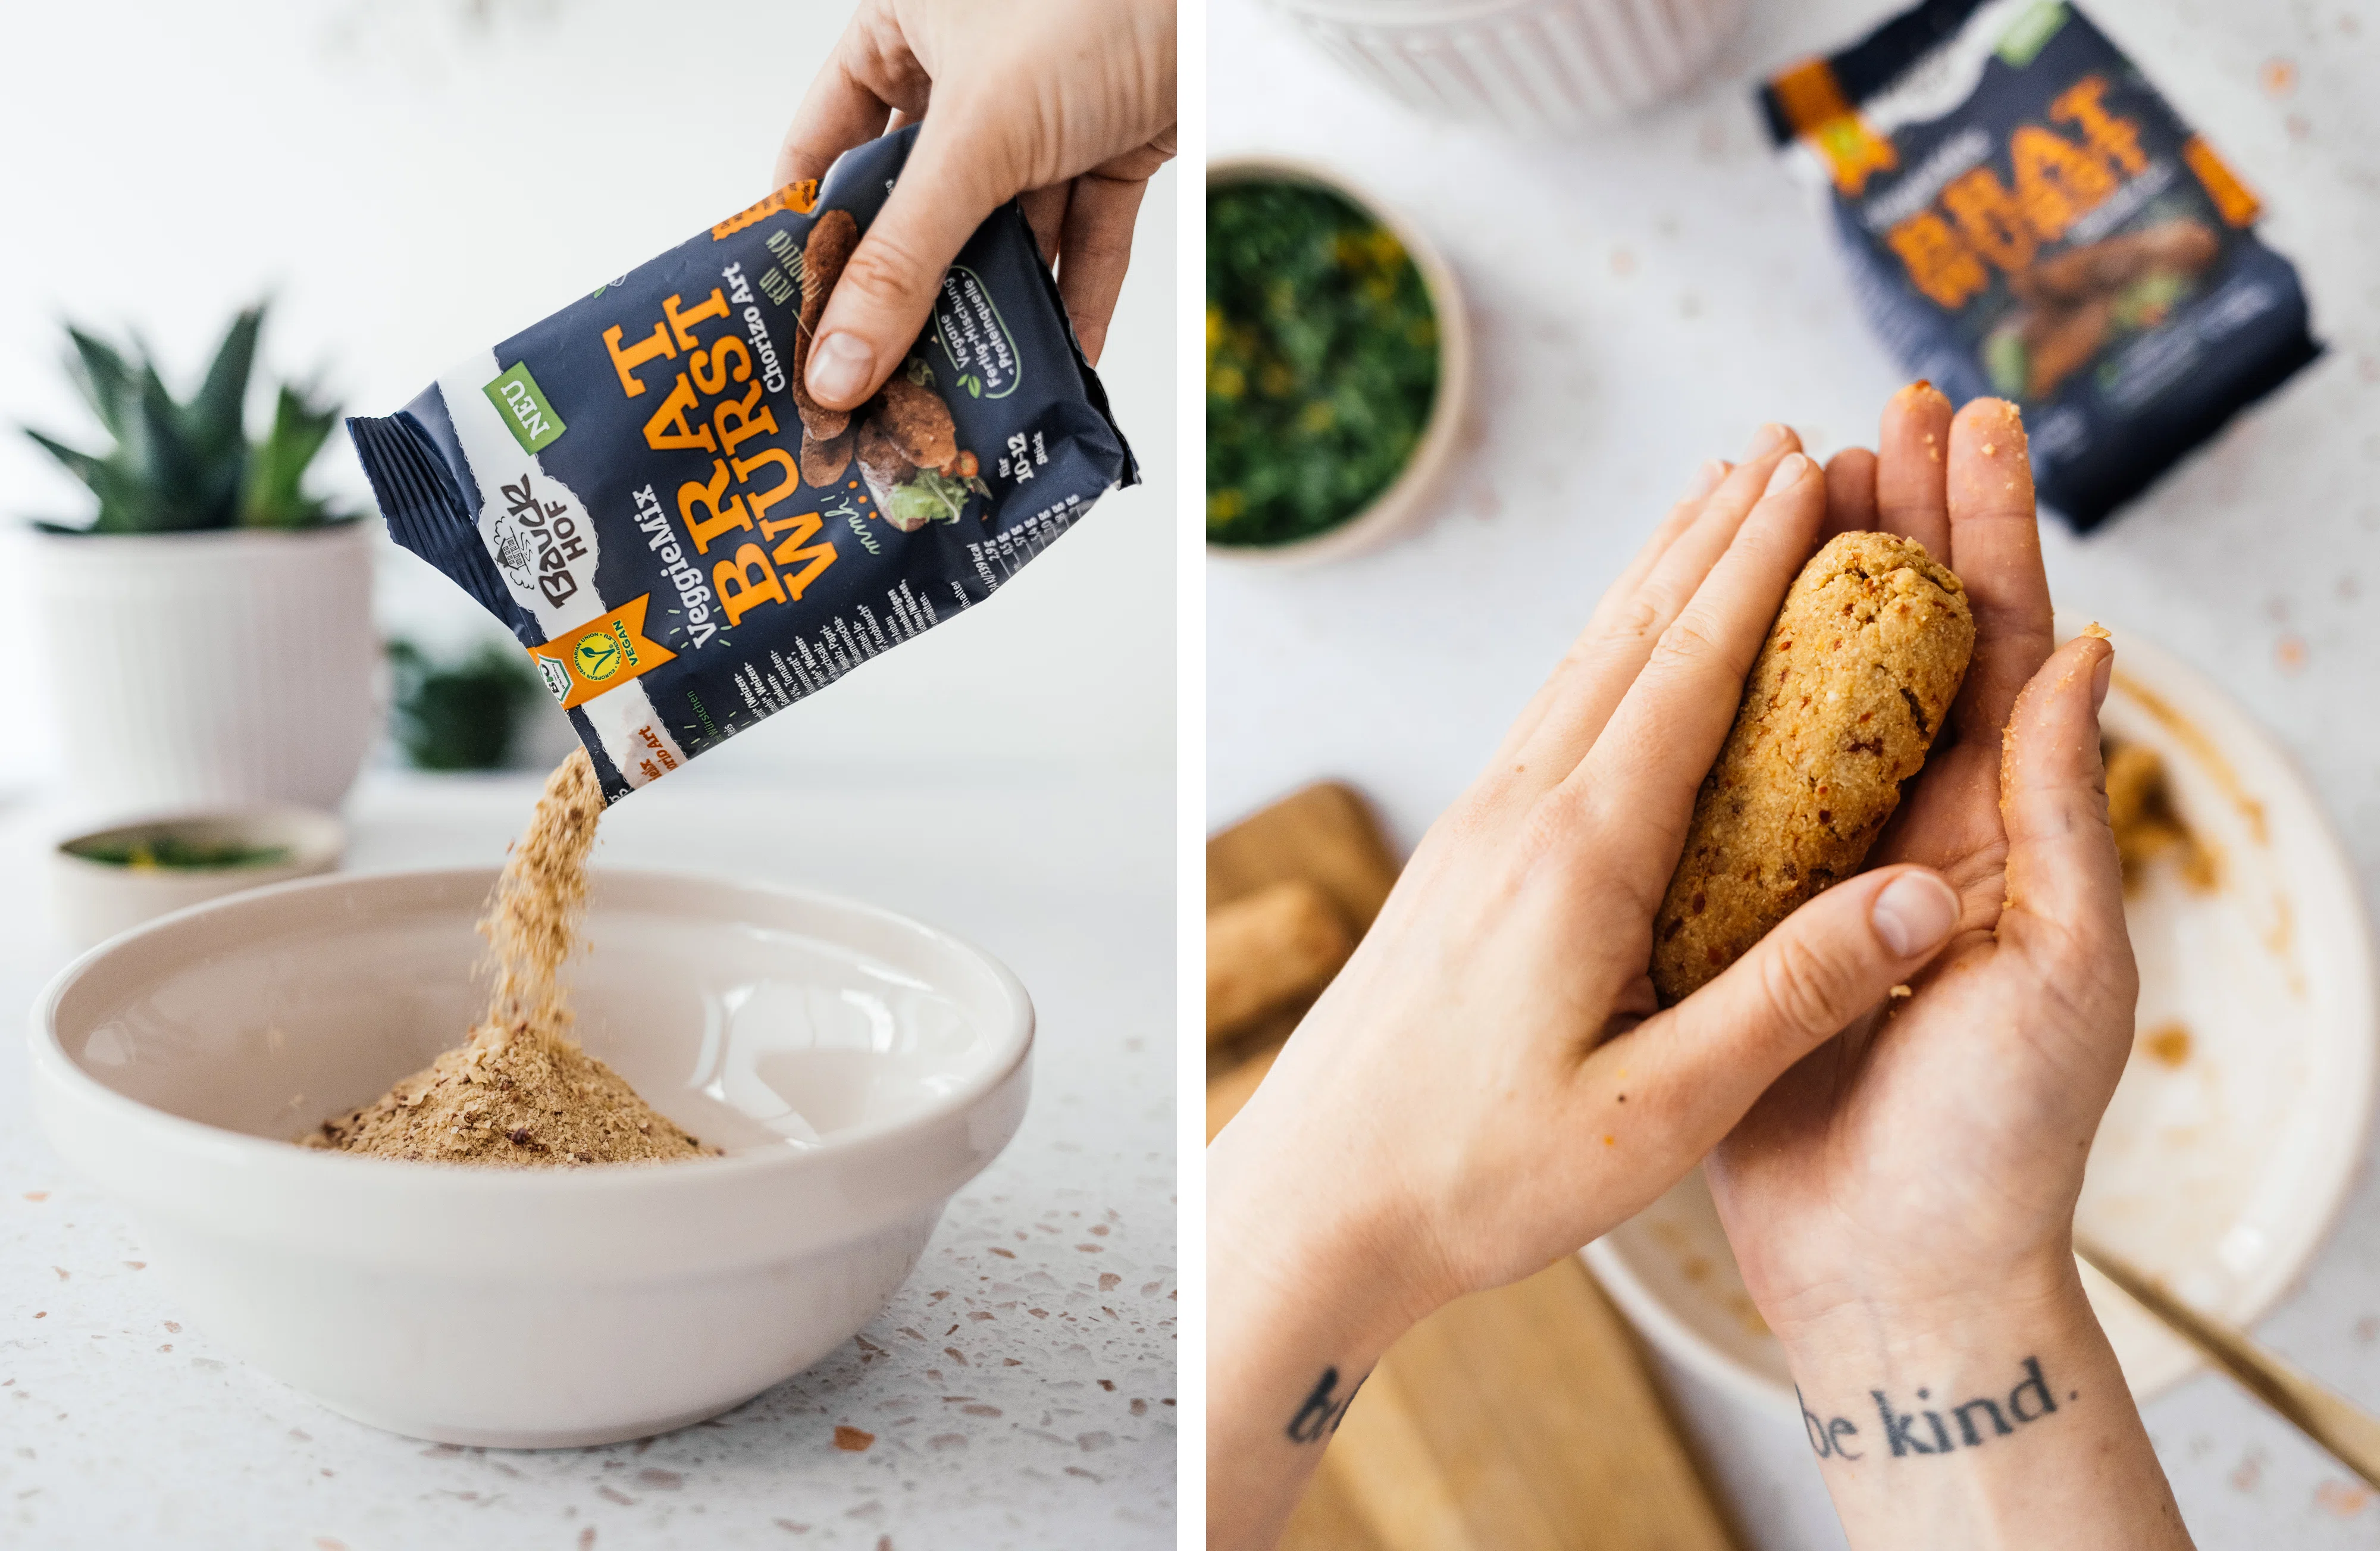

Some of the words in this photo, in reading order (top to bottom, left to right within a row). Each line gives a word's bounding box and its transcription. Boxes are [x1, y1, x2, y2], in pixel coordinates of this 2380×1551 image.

[719, 261, 754, 302] Art
[758, 267, 795, 306] REIN
[940, 314, 970, 368] Vegane
[943, 277, 1001, 387] Fertig-Mischung
[964, 278, 1013, 368] Proteinquelle
[742, 306, 786, 391] Chorizo
[500, 380, 550, 441] NEU
[661, 287, 839, 601] WURST
[1006, 431, 1035, 484] 10-12
[1032, 430, 1048, 464] Stück
[600, 321, 787, 627] BRAT
[998, 458, 1010, 477] für
[543, 500, 588, 562] HOF
[631, 483, 718, 649] VeggieMix
[966, 542, 985, 561] kcal
[884, 615, 900, 637] Anbau
[886, 588, 917, 637] glutenhaltigen
[919, 591, 938, 625] enthalten.
[580, 632, 598, 642] UNION
[612, 619, 638, 666] VEGAN
[819, 625, 839, 650] Papri-
[833, 616, 864, 666] Flohsamenscha-
[853, 621, 864, 634] Jo-
[574, 642, 585, 675] VEGETARIAN
[603, 634, 621, 664] V-LABEL.EU
[794, 635, 817, 669] Weizen-
[813, 640, 837, 675] Rauchsalz
[586, 668, 615, 679] EUROPEAN
[744, 661, 767, 696] Weizen-
[770, 649, 794, 687] Tomaten-
[734, 673, 759, 706] (Weizen-
[767, 673, 790, 706] Grünkern-
[686, 690, 718, 737] Würstchen
[724, 723, 737, 736] Reis
[638, 725, 663, 748] Art
[1795, 1383, 1864, 1460] be
[1869, 1355, 2078, 1458] kind.
